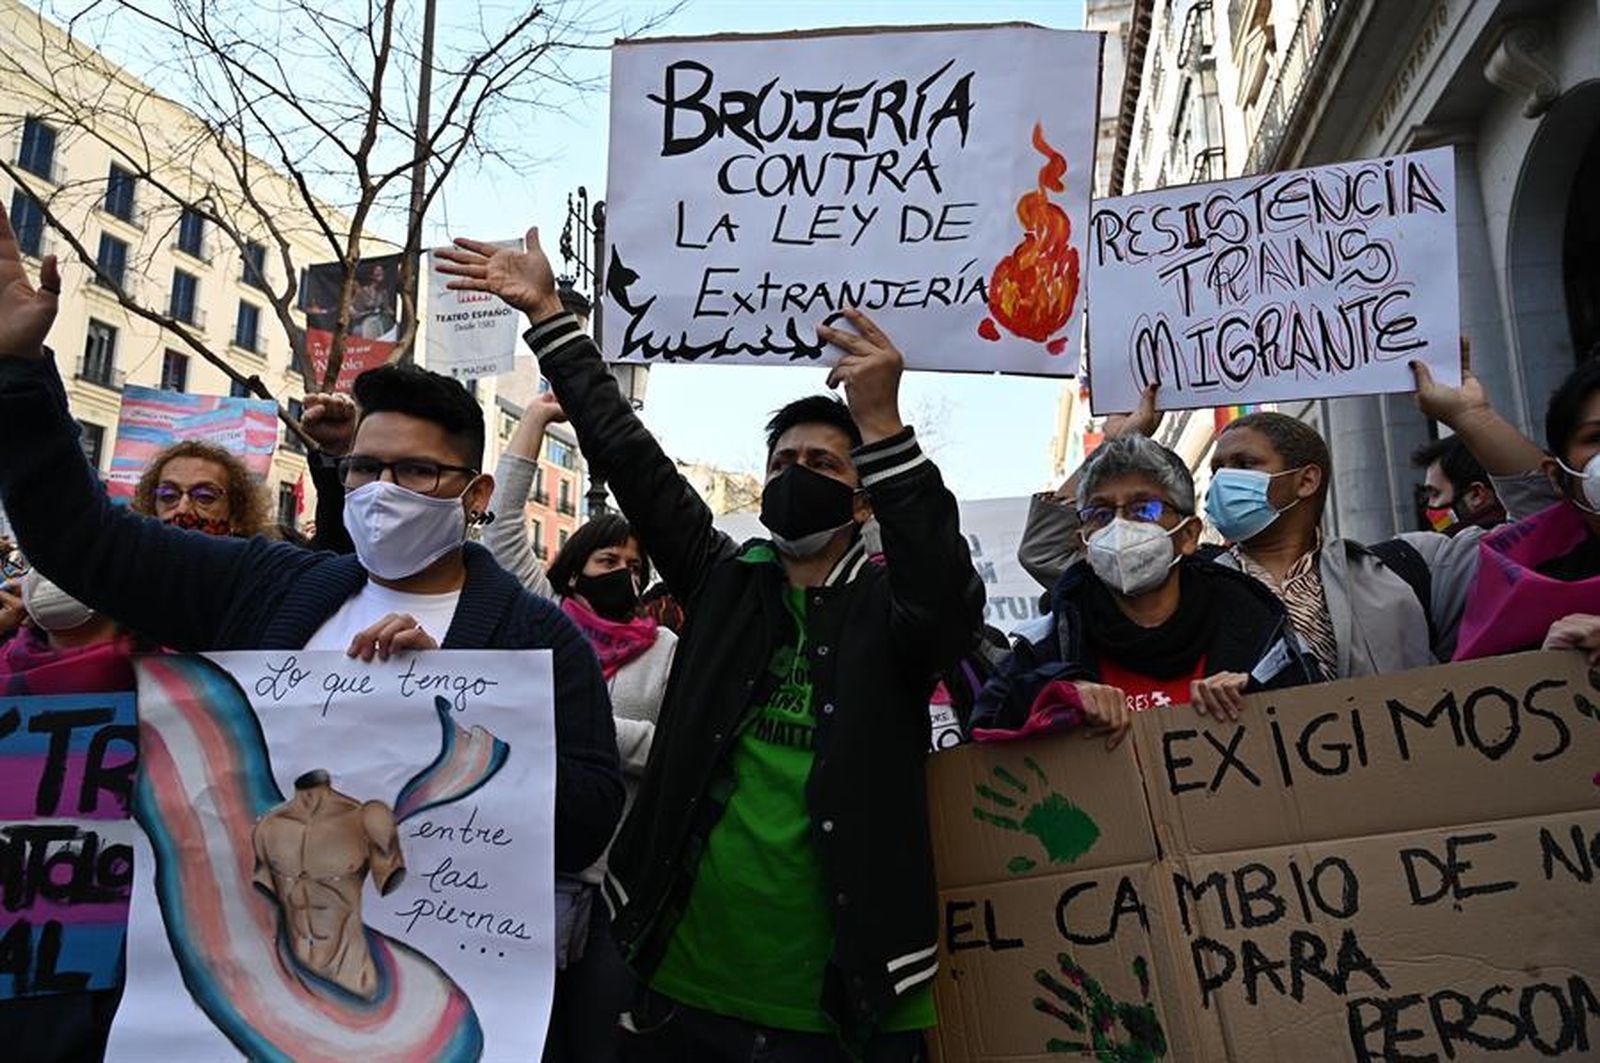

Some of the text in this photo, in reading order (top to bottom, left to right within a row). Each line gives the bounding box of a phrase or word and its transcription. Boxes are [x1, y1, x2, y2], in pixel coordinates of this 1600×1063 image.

[647, 59, 976, 157] BRUJERÍA
[717, 150, 943, 197] CONTRA
[676, 200, 979, 249] LA LEY DE
[1091, 160, 1447, 266] RESISTENCIA
[1158, 228, 1397, 317] TRANS
[436, 312, 470, 322] TEATRO
[1132, 290, 1428, 392] MIGRANTE
[255, 656, 498, 717] Lo que tengo
[1126, 695, 1149, 711] RES
[28, 707, 140, 817] TR
[1160, 679, 1571, 796] EXIGIMOS
[408, 805, 512, 847] entre
[421, 858, 489, 892] las
[945, 900, 1024, 954] EL
[1400, 831, 1519, 906] DE
[1540, 825, 1600, 884] N
[394, 897, 533, 941] piernas
[1190, 927, 1393, 1008] PARA
